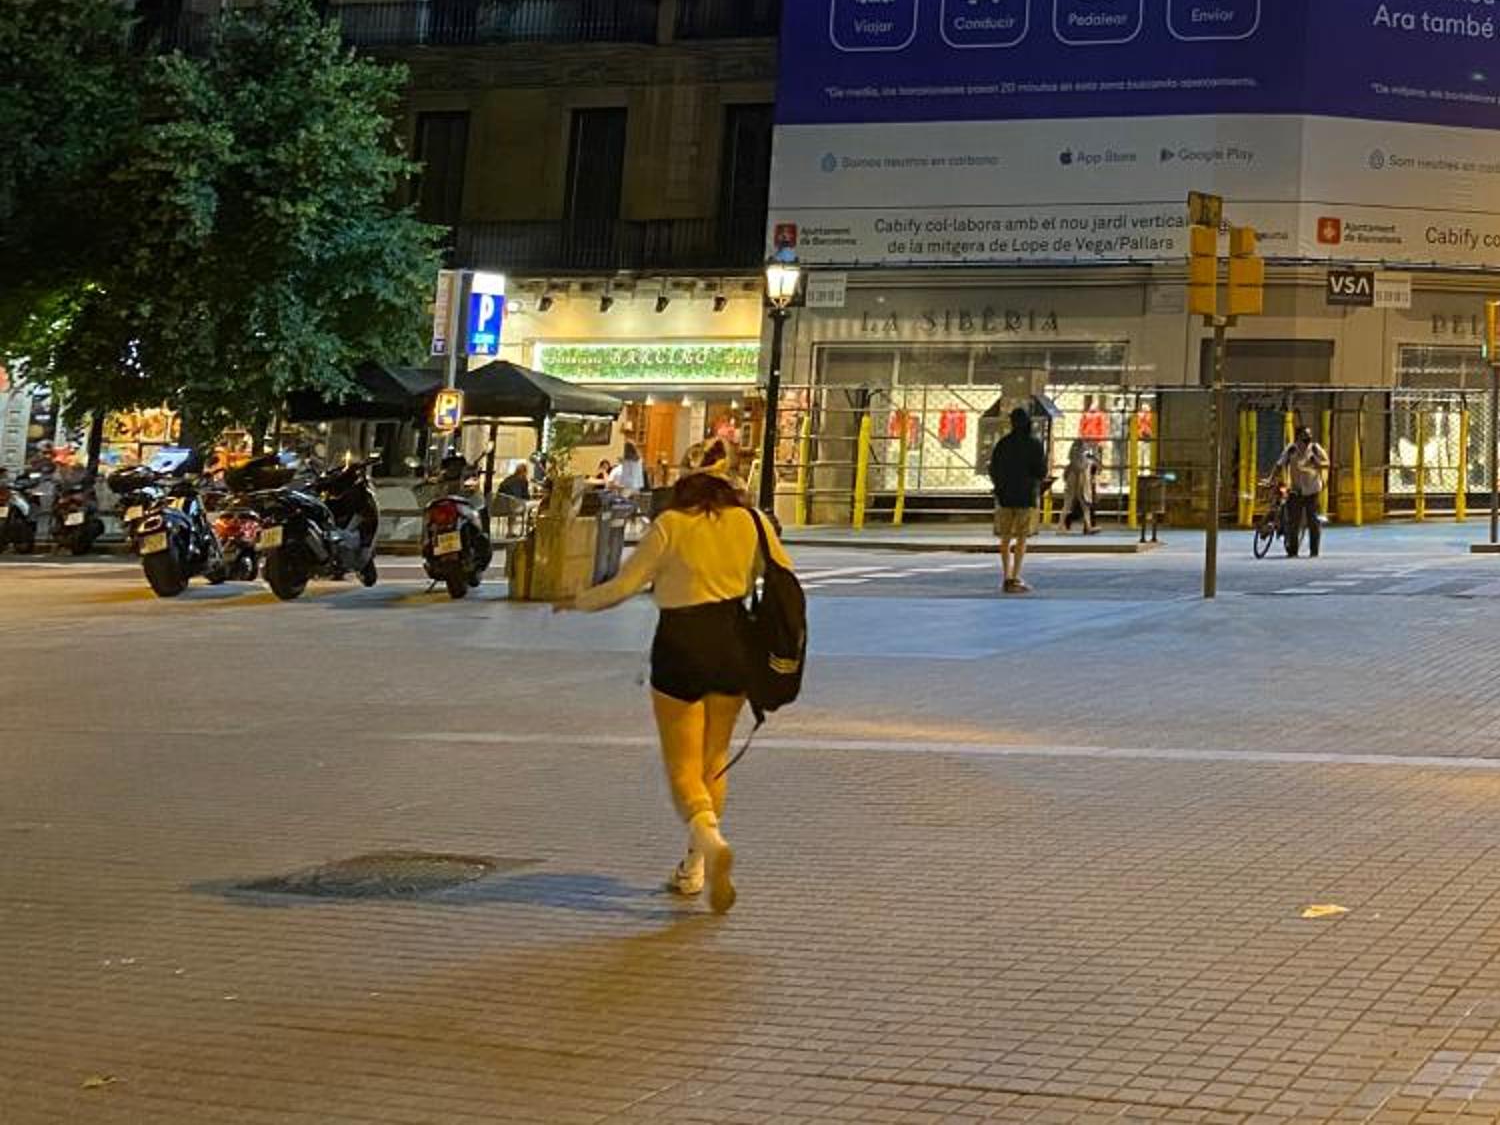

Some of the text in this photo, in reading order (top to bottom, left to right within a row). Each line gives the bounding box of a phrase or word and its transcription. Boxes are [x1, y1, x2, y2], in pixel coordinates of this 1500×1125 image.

[953, 17, 1017, 31] Conducir
[1191, 8, 1235, 23] Enviar
[1373, 4, 1415, 30] Ara
[1422, 10, 1494, 38] també
[854, 20, 894, 35] Viajar
[874, 218, 922, 235] Cabify
[1003, 217, 1038, 232] amb
[1040, 215, 1055, 230] el
[1061, 217, 1090, 230] nou
[887, 239, 905, 254] de
[908, 239, 923, 254] la
[926, 238, 985, 255] mitgera
[989, 236, 1008, 252] de
[1011, 236, 1049, 255] Lope
[1052, 236, 1072, 252] de
[1424, 226, 1480, 250] Cabify
[1330, 276, 1370, 295] VSA
[477, 293, 495, 332] P
[861, 310, 899, 332] LA
